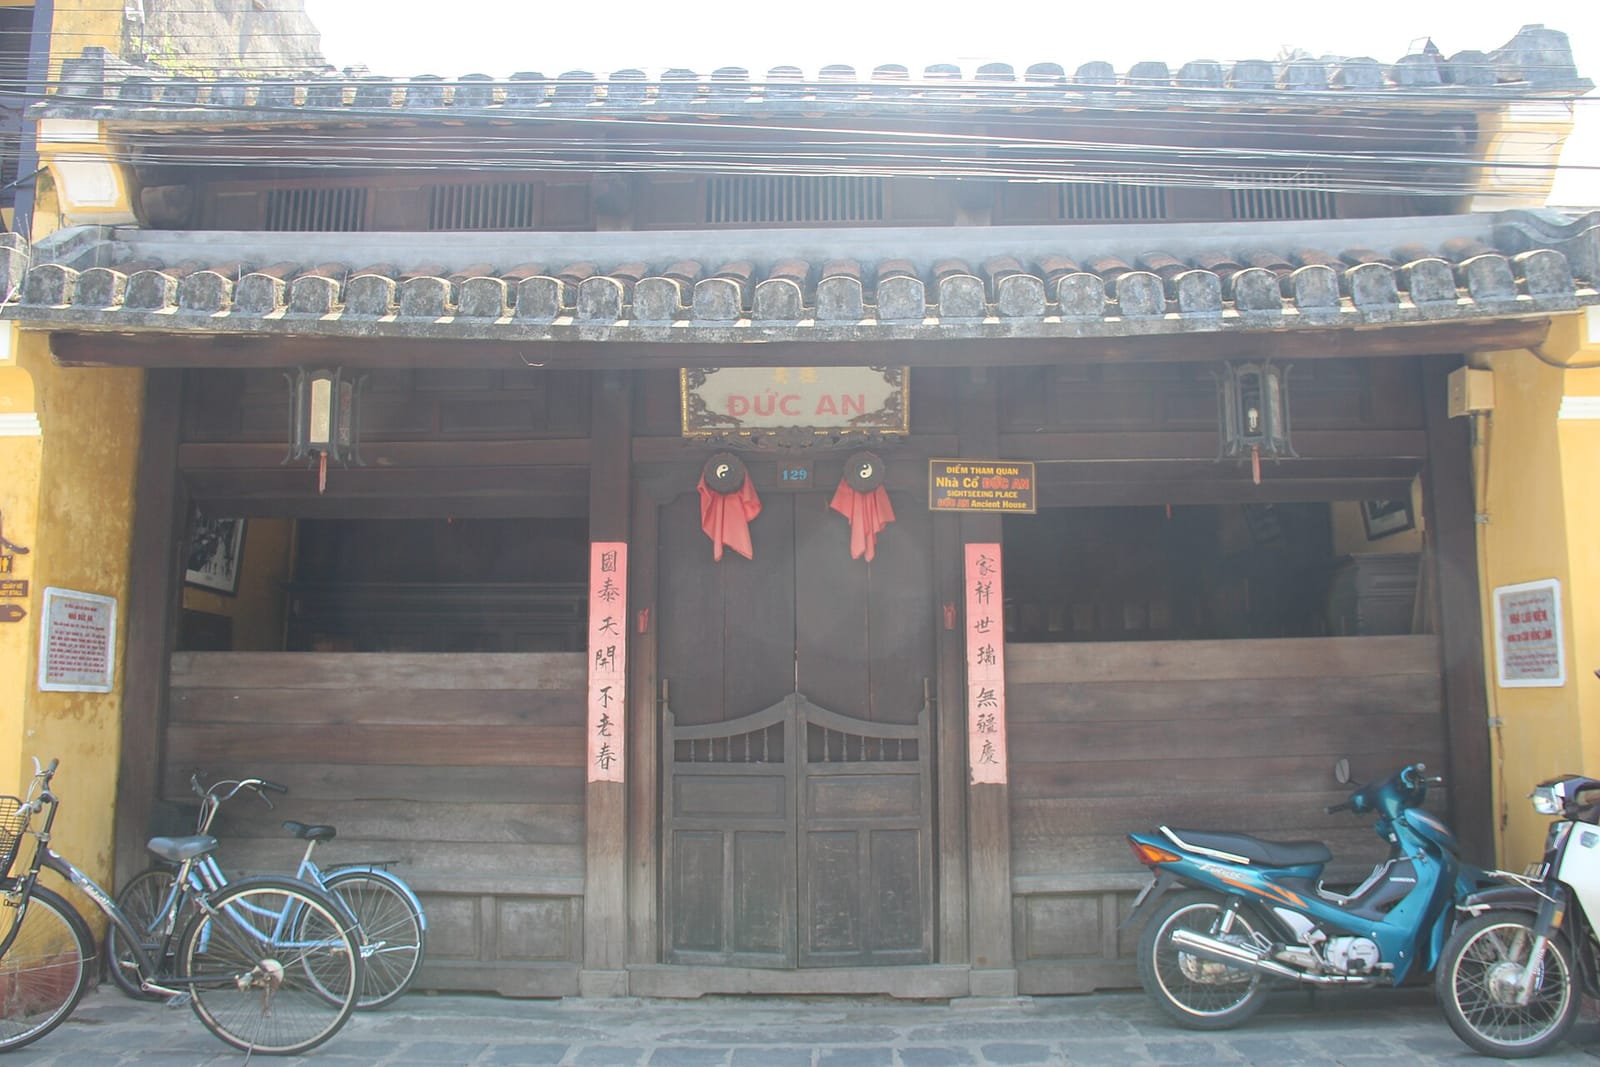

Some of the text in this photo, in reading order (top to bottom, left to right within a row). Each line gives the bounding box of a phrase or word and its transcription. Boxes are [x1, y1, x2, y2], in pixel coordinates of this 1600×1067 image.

[727, 388, 865, 417] ĐỨC AN
[783, 469, 808, 481] 129
[970, 466, 994, 475] THAM
[996, 467, 1019, 476] QUAN
[936, 477, 959, 488] Nhà
[1011, 478, 1030, 490] AN
[946, 490, 1018, 499] SIGHTSEEING PLACE
[971, 499, 1000, 508] Ancient
[1002, 500, 1026, 509] House
